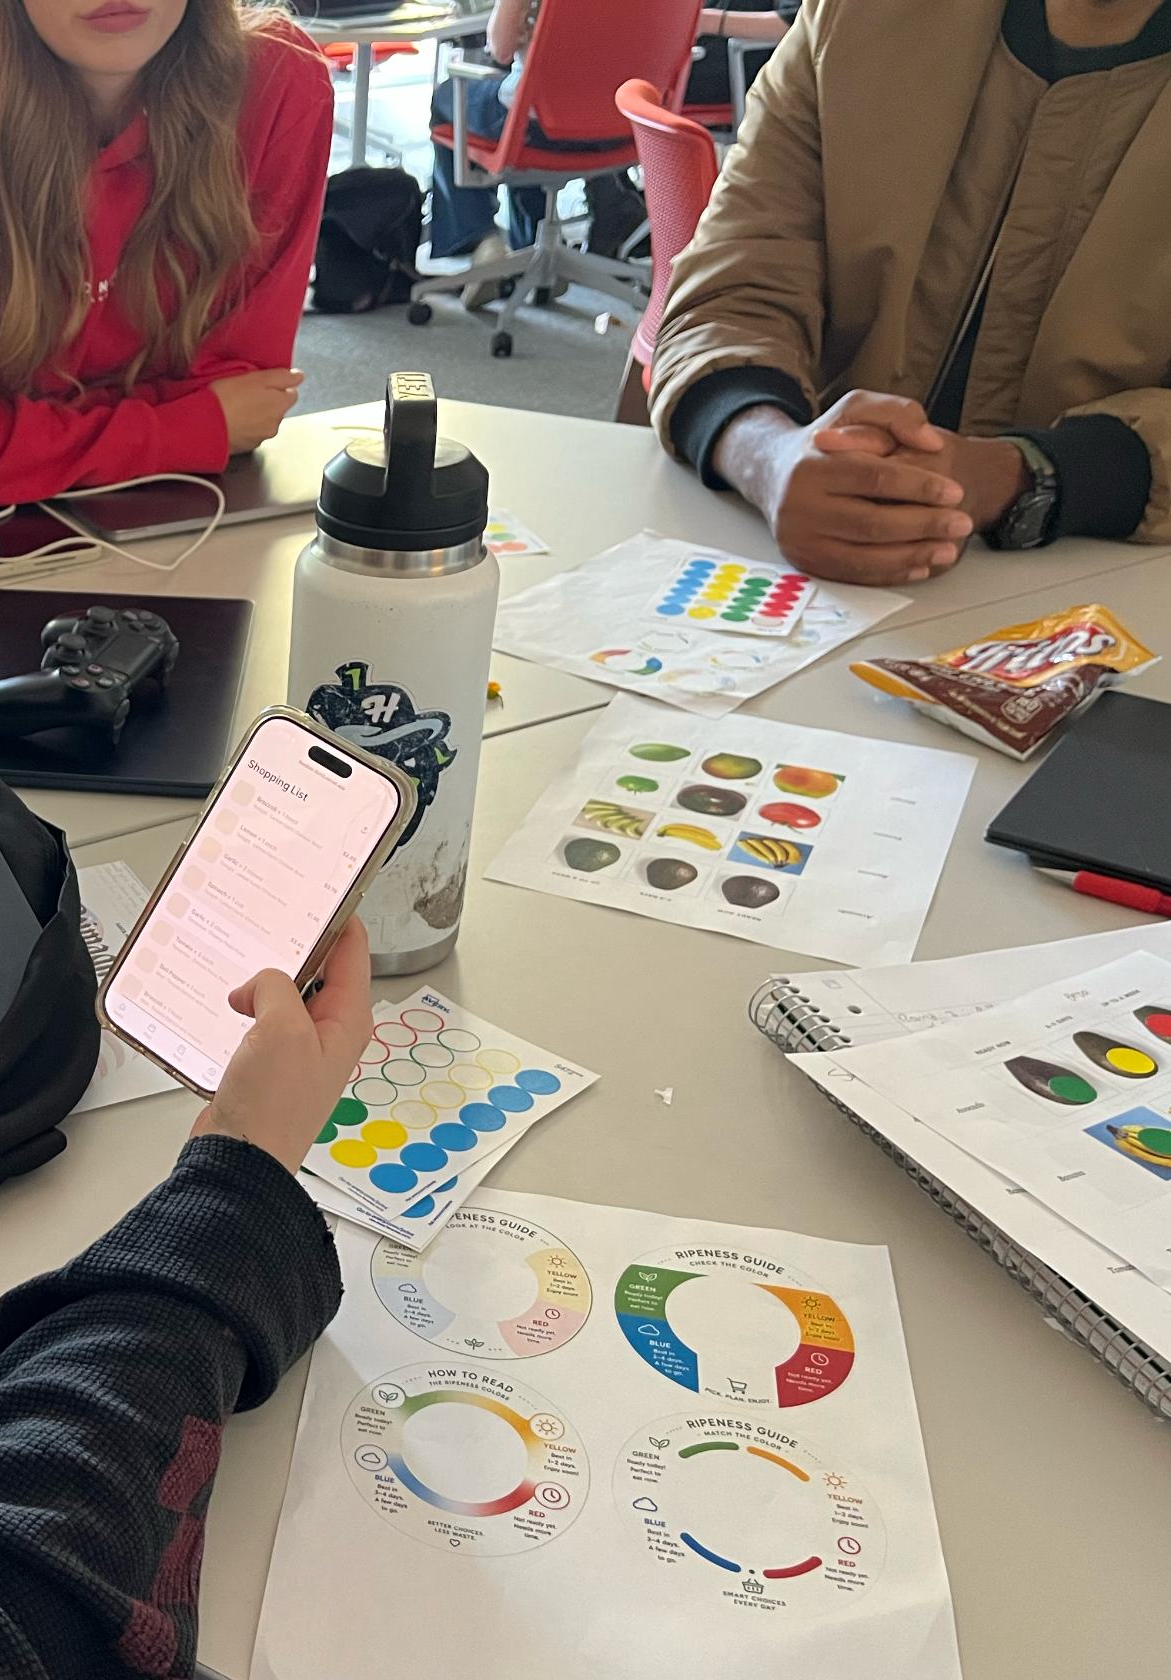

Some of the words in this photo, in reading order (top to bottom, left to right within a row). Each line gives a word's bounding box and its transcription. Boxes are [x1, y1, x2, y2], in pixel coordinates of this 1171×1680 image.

[396, 373, 430, 401] YETI
[361, 692, 401, 724] H
[246, 759, 291, 792] Shopping
[290, 785, 309, 802] List
[455, 1212, 495, 1224] ENESS
[500, 1217, 538, 1238] GUIDE
[499, 1228, 525, 1241] COLOR
[675, 1249, 738, 1261] RIPENESS
[743, 1255, 785, 1275] GUIDE
[547, 1270, 577, 1279] YELLOW
[740, 1265, 769, 1278] COLOR
[629, 1284, 656, 1293] GREEN
[403, 1296, 423, 1304] BLUE
[803, 1312, 835, 1322] YELLOW
[649, 1340, 671, 1349] BLUE
[804, 1366, 822, 1375] RED
[428, 1370, 457, 1378] HOW
[462, 1371, 478, 1380] TO
[482, 1375, 513, 1393] READ
[444, 1380, 479, 1389] RIPENESS
[481, 1386, 510, 1400] COLORS
[361, 1406, 385, 1415] GREEN
[686, 1418, 752, 1430] RIPENESS
[757, 1427, 798, 1449] GUIDE
[544, 1442, 577, 1454] YELLOW
[754, 1437, 782, 1450] COLOR
[632, 1451, 660, 1460] GREEN
[374, 1474, 395, 1483] BLUE
[827, 1493, 863, 1504] YELLOW
[528, 1510, 545, 1518] RED
[427, 1520, 451, 1529] BETTER
[644, 1518, 666, 1527] BLUE
[838, 1559, 856, 1568] RED
[723, 1591, 749, 1599] SMART
[751, 1596, 786, 1606] CHOICES
[734, 1599, 758, 1608] EVERY
